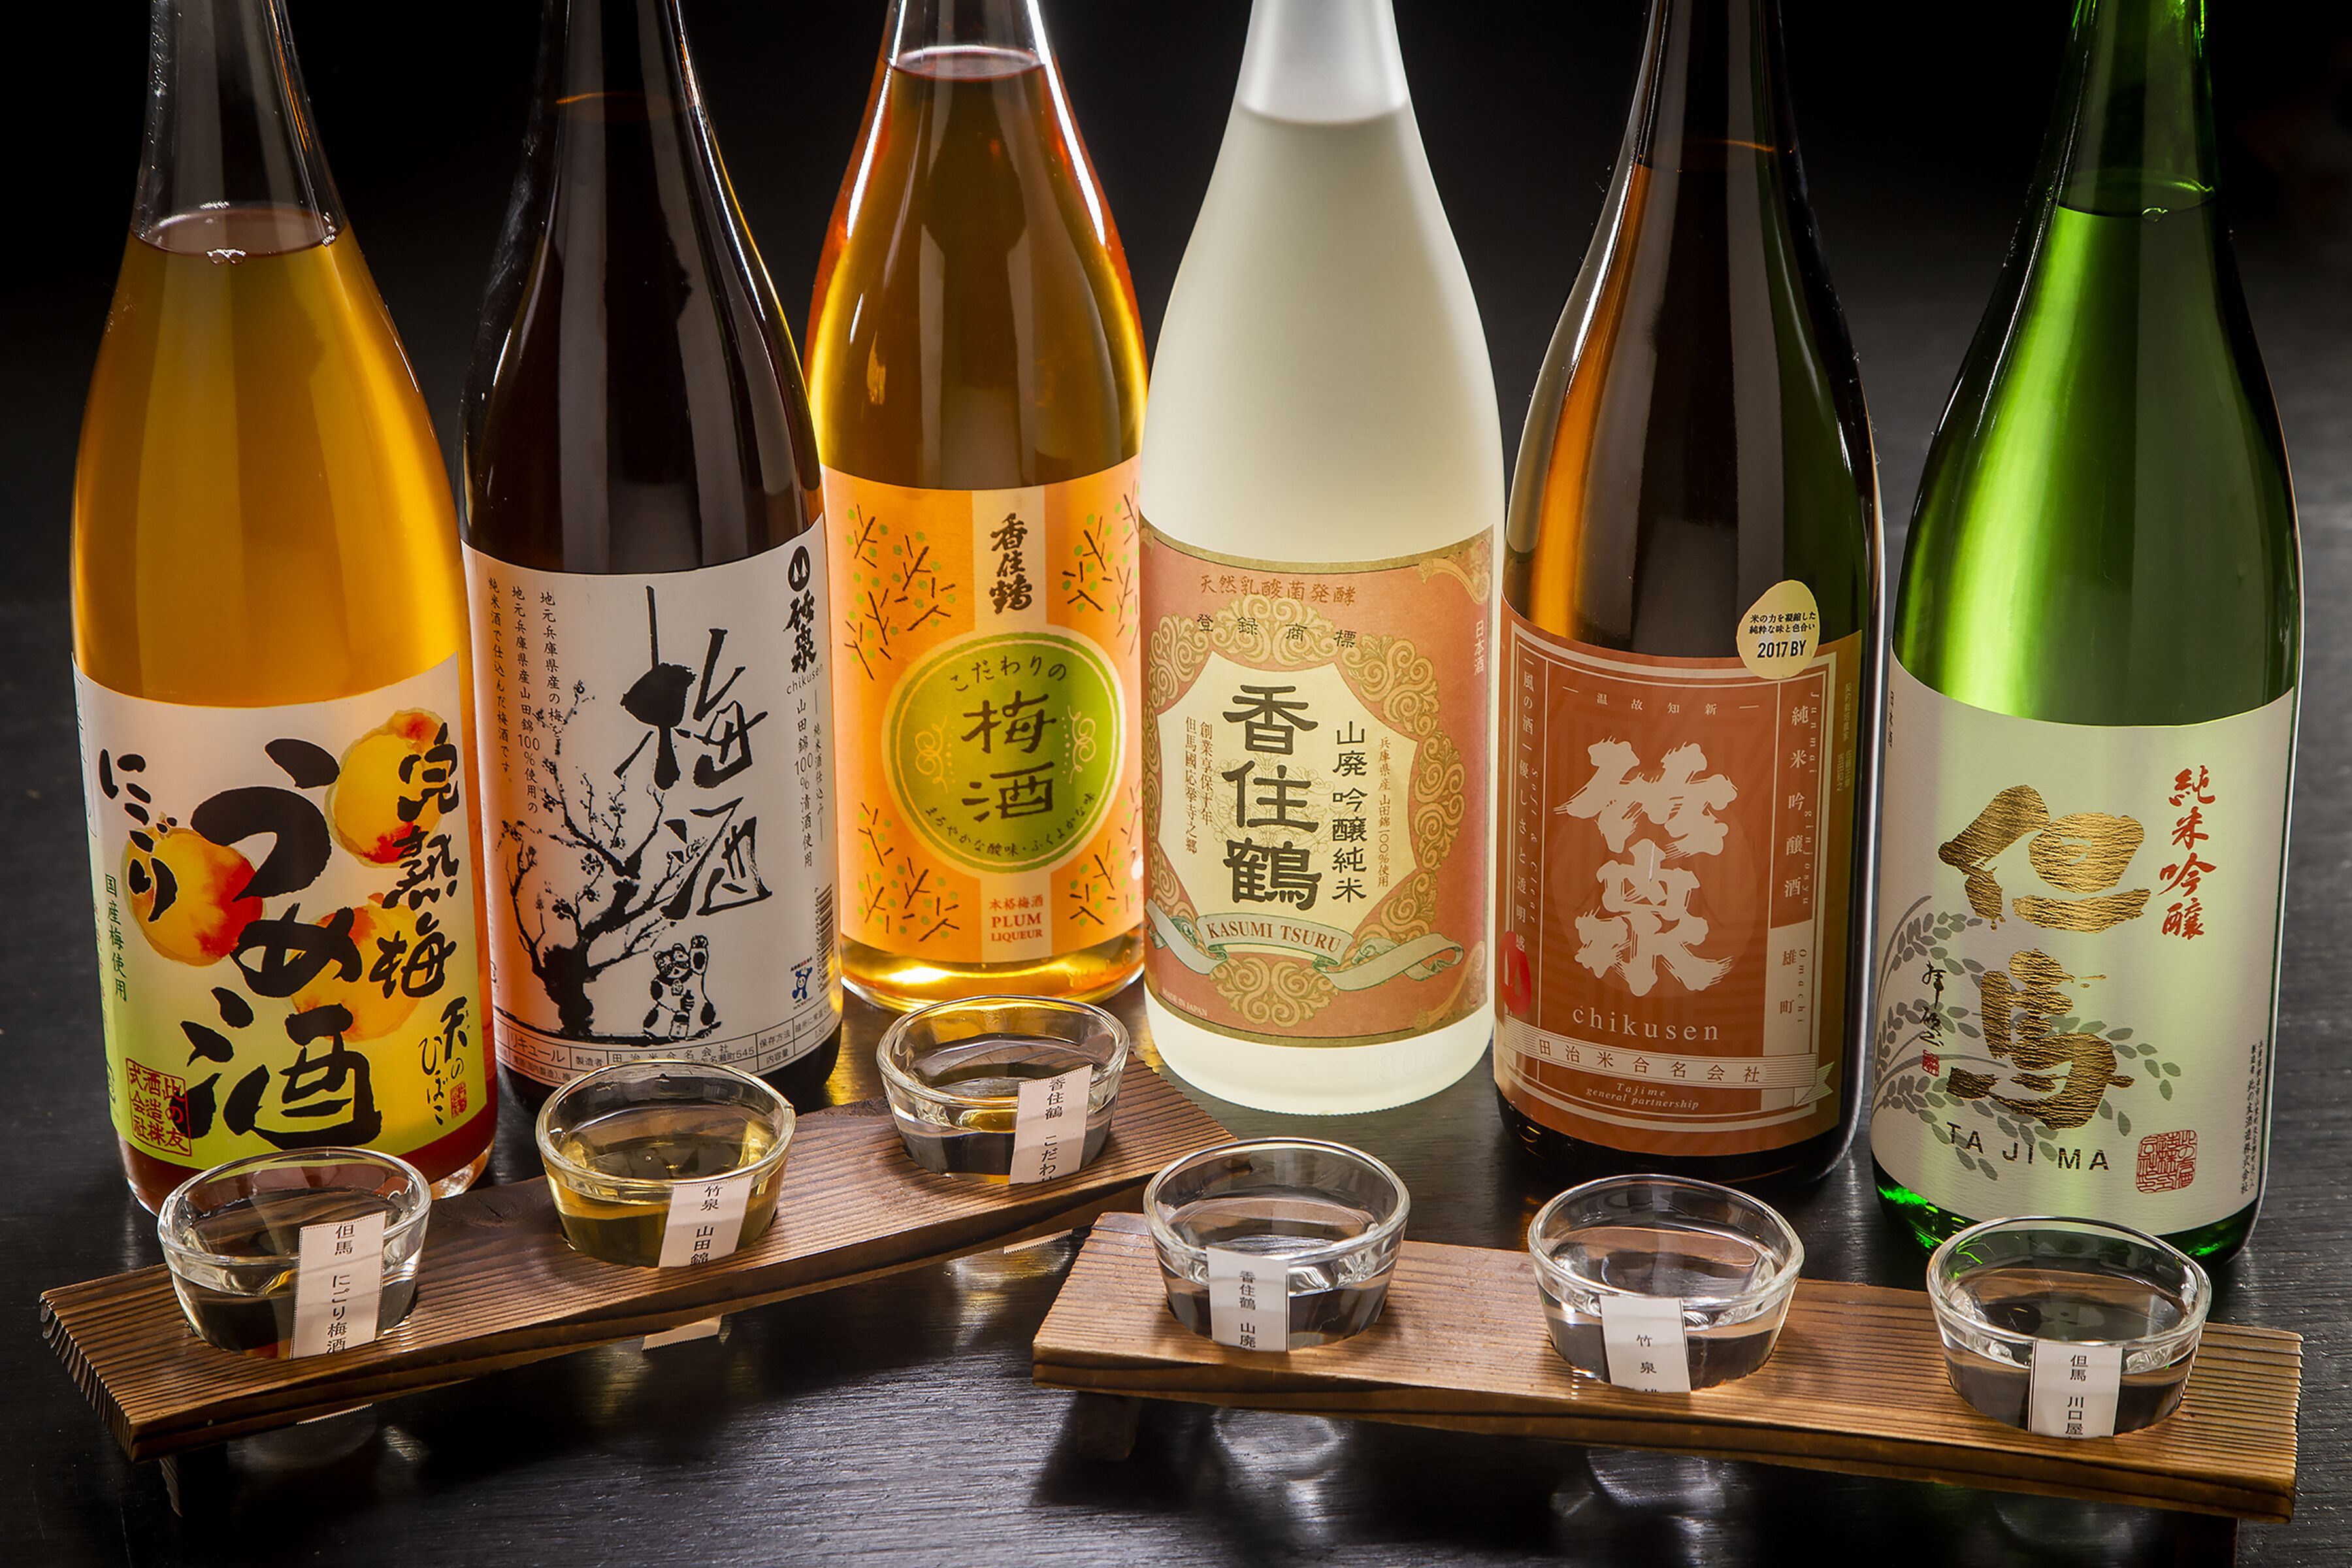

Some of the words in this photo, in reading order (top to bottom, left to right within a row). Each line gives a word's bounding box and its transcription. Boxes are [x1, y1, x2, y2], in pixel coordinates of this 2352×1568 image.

[990, 512, 1033, 614] 香住鶴
[1201, 575, 1356, 607] 天然乳酸菌発酵
[1197, 613, 1357, 648] 登録商標
[1749, 623, 1815, 634] 純粋な味と色合い
[1750, 612, 1816, 623] 米の力を凝縮した
[1475, 619, 1485, 676] 日本酒
[1757, 642, 1788, 658] 2017
[1790, 640, 1806, 657] BY
[786, 663, 824, 694] chikusen
[950, 654, 1067, 693] こだわりの
[512, 586, 540, 813] 地元兵庫県産山田錦100%使用の
[1597, 693, 1717, 715] 温故知新
[614, 585, 772, 919] 梅酒
[1809, 691, 1819, 773] Junmai
[960, 690, 1057, 823] 梅酒
[1200, 721, 1213, 826] 創業享保十年
[794, 698, 813, 868] 山田錦100%清酒使用
[1221, 683, 1322, 911] 香住鶴
[1784, 706, 1809, 898] 純米吟醸酒
[1332, 721, 1368, 903] 山廃吟醸純米
[99, 749, 177, 921] にごり
[2157, 765, 2217, 941] 純米吟醸
[368, 722, 462, 999] 完熟梅
[1554, 736, 1737, 997] 竹泉
[1802, 811, 1813, 904] ginjosyu
[989, 894, 1043, 911] 本格梅酒
[991, 912, 1041, 928] PLUM
[105, 873, 127, 1002] 国産梅使用
[168, 738, 384, 1151] うめ酒
[990, 929, 1043, 943] LIQUEUR
[1206, 921, 1273, 939] KASUMI
[1280, 925, 1341, 953] TSURU
[1938, 784, 2152, 1131] 但馬
[1780, 949, 1797, 1014] 雄町
[1797, 949, 1806, 1022] Omachi
[1185, 998, 1208, 1016] JAPAN
[1573, 1007, 1719, 1041] chikusen
[510, 1033, 565, 1062] リキュール
[576, 1056, 603, 1066] 製造者
[759, 1032, 791, 1049] 保存方法
[766, 1049, 789, 1064] 内容量
[1539, 1039, 1760, 1083] 田治米合名会社
[128, 1066, 150, 1141] 式会社
[143, 1072, 166, 1146] 酒造株
[1045, 1077, 1066, 1120] 香住鶴
[1586, 1087, 1626, 1102] general
[1631, 1095, 1699, 1110] partnership
[1616, 1083, 1665, 1097] Tajime
[161, 1077, 189, 1152] 此の友
[700, 1186, 723, 1211] 竹泉
[335, 1225, 354, 1255] 但馬
[690, 1226, 714, 1266] 山田錦
[1239, 1271, 1256, 1311] 香住鶴
[327, 1275, 350, 1354] にごり梅酒
[1637, 1335, 1657, 1374] 竹泉
[2070, 1355, 2088, 1381] 但馬
[2065, 1397, 2083, 1435] 川口屋
